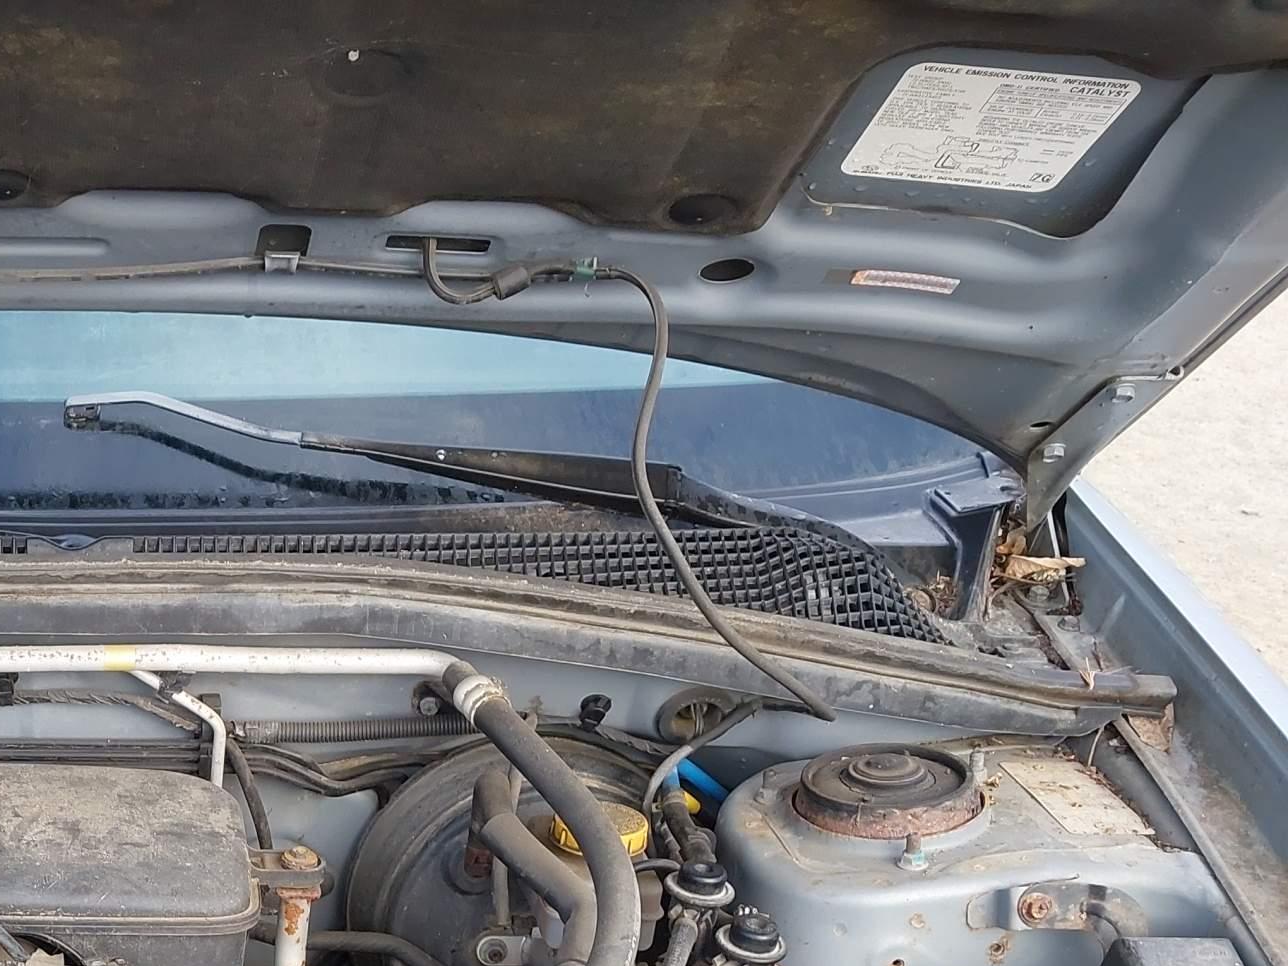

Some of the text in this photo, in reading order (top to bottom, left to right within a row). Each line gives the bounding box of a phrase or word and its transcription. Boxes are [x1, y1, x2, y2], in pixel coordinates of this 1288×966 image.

[923, 65, 1130, 90] VEHICLE EMISSION CONTROL INFORMATION
[1069, 86, 1131, 98] CATALYST
